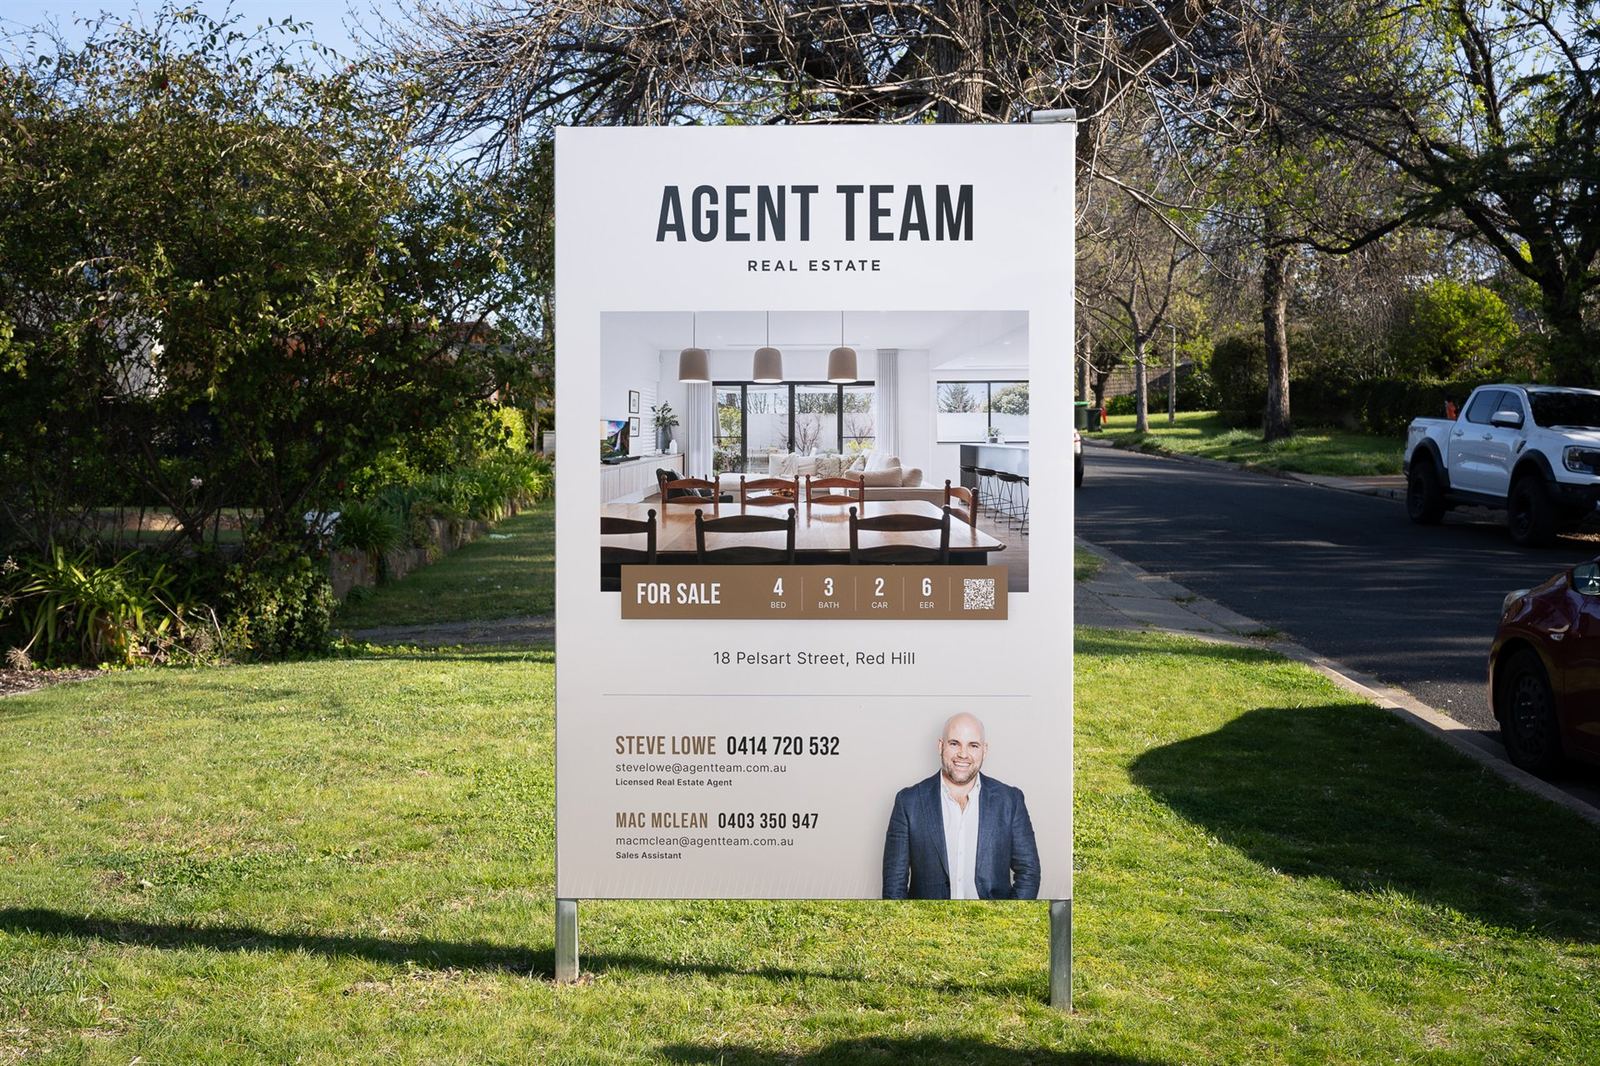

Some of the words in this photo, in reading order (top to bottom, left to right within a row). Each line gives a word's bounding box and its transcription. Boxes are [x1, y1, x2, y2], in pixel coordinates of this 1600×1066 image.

[656, 185, 818, 242] AGENT
[836, 185, 973, 241] TEAM
[747, 259, 798, 272] REAL
[808, 259, 881, 272] ESTATE
[638, 583, 670, 604] FOR
[677, 583, 720, 604] SALE
[774, 578, 783, 596] 4
[824, 578, 833, 596] 3
[875, 578, 884, 596] 2
[922, 578, 931, 596] 6
[770, 601, 787, 609] BED
[818, 601, 840, 609] BATH
[871, 601, 889, 609] CAR
[919, 601, 935, 609] EER
[713, 651, 731, 665] 18
[736, 651, 792, 665] Pelsart
[798, 652, 849, 667] Street,
[855, 651, 885, 665] Red
[891, 651, 915, 665] Hill
[616, 736, 665, 754] STEVE
[672, 736, 716, 754] LOWE
[727, 736, 767, 755] 0414
[773, 736, 803, 755] 720
[810, 737, 839, 755] 532
[615, 762, 787, 775] stevelowe@agentteam.com.au
[615, 777, 655, 786] Licensed
[656, 778, 675, 786] Real
[676, 778, 705, 787] Estate
[706, 778, 733, 788] Agent
[617, 813, 645, 828] MAC
[652, 813, 707, 828] MCLEAN
[719, 813, 754, 828] 0403
[760, 813, 786, 828] 350
[793, 813, 818, 828] 947
[615, 835, 794, 849] macmclean@agentteam.com.au
[615, 851, 640, 860] Sales
[640, 851, 682, 860] Assistant
